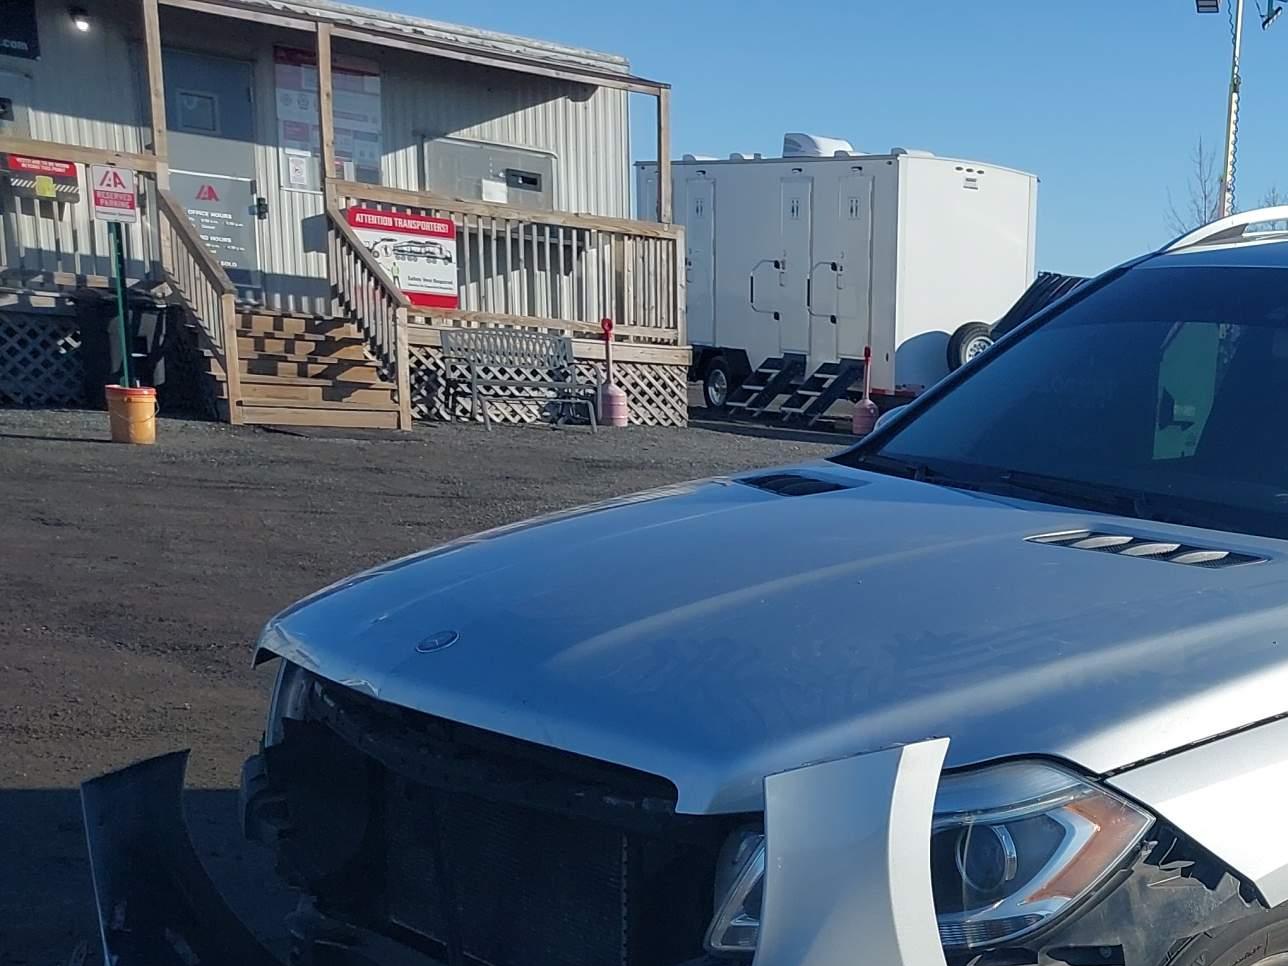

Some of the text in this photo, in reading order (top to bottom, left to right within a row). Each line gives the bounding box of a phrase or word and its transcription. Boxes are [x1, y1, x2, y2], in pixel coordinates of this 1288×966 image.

[96, 191, 133, 201] RESERVED
[99, 199, 130, 208] PARKING
[355, 213, 449, 233] ATTENTION TRANSPORTERS!
